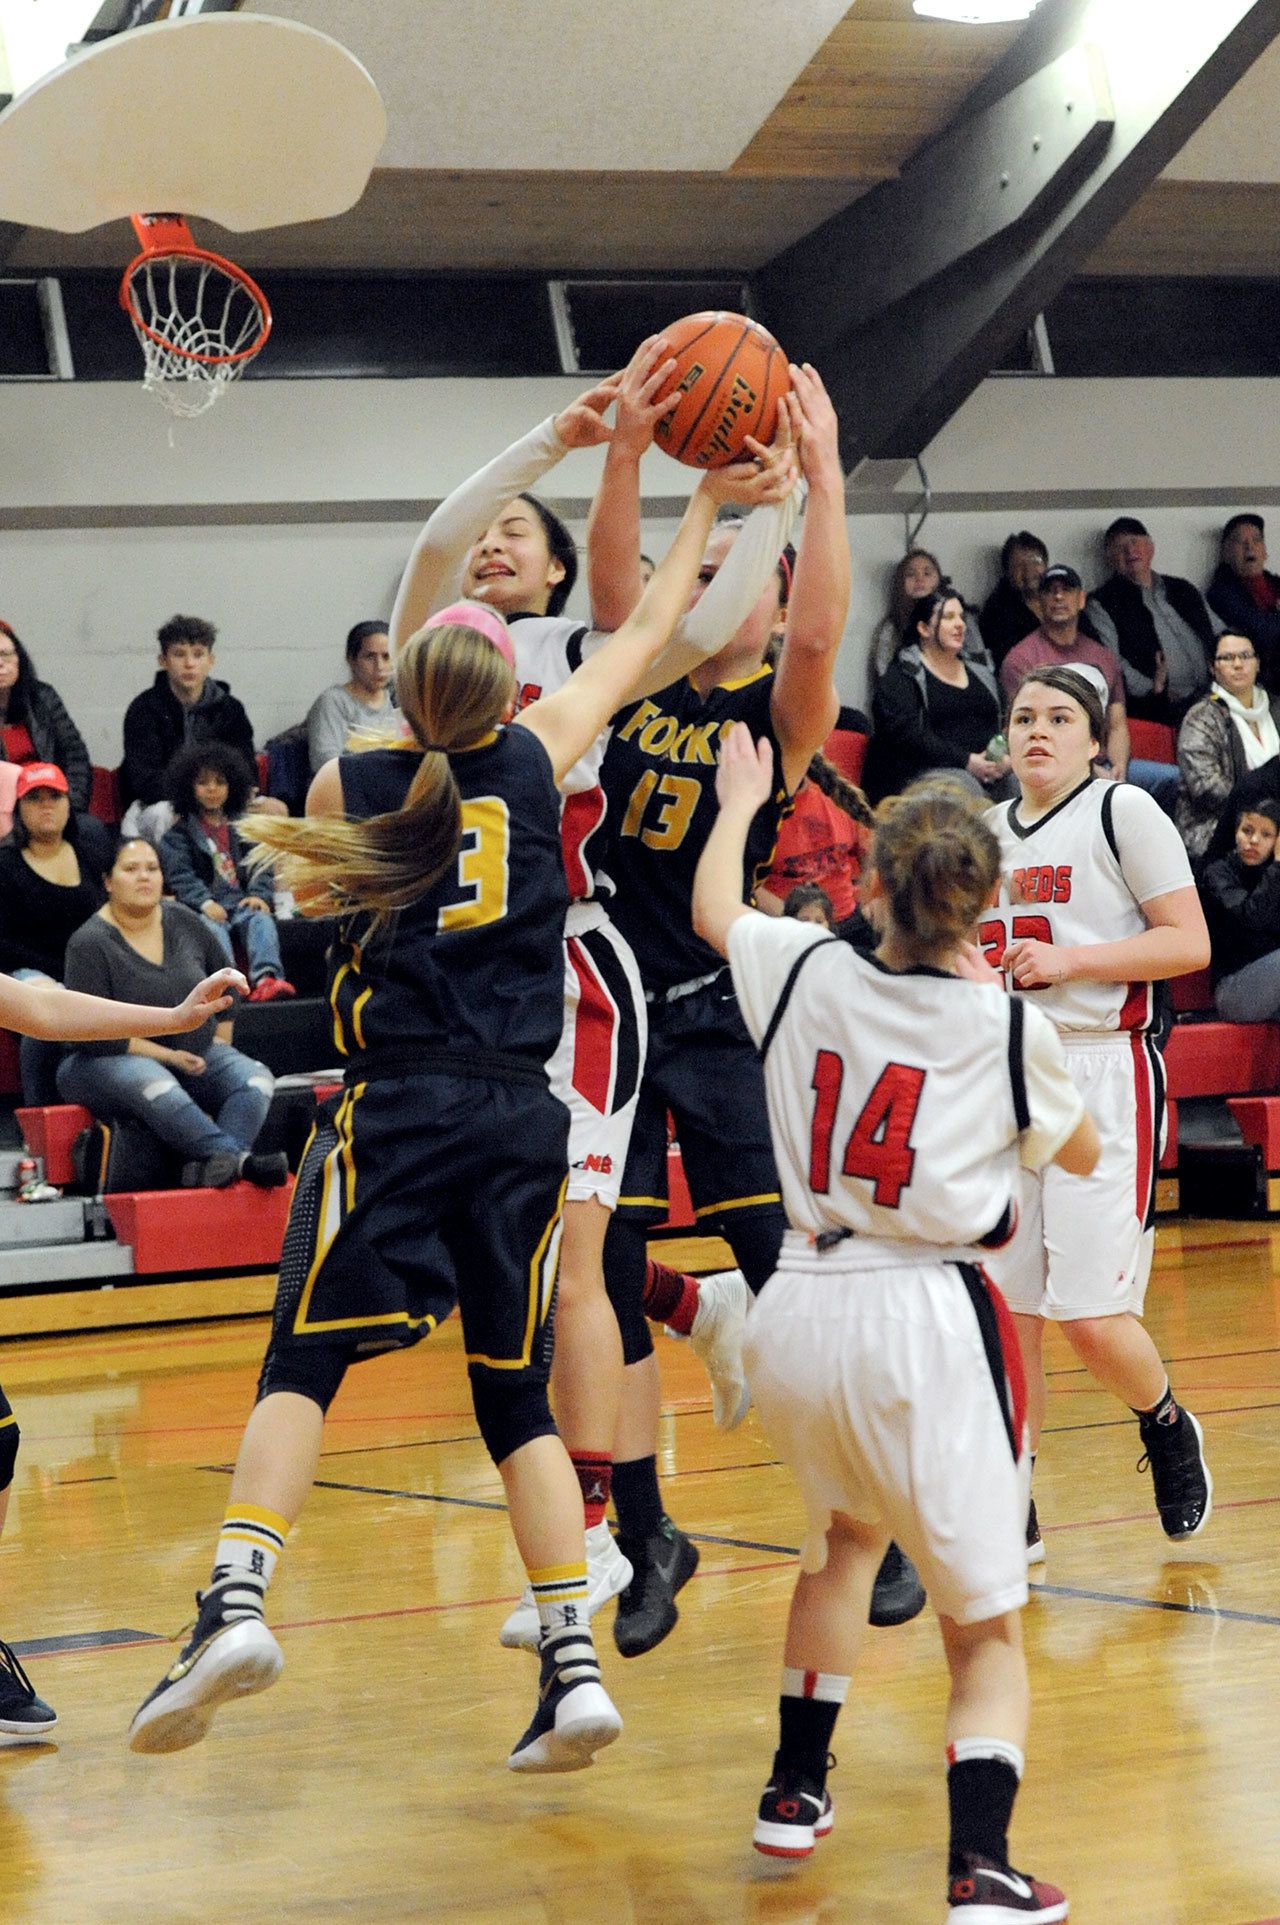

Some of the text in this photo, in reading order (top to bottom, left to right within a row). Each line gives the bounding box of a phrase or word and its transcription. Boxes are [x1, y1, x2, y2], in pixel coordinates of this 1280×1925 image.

[617, 699, 736, 766] FOK
[620, 768, 702, 851] 13
[436, 795, 511, 935] 3
[1009, 865, 1073, 905] REDS
[809, 1049, 927, 1209] 14
